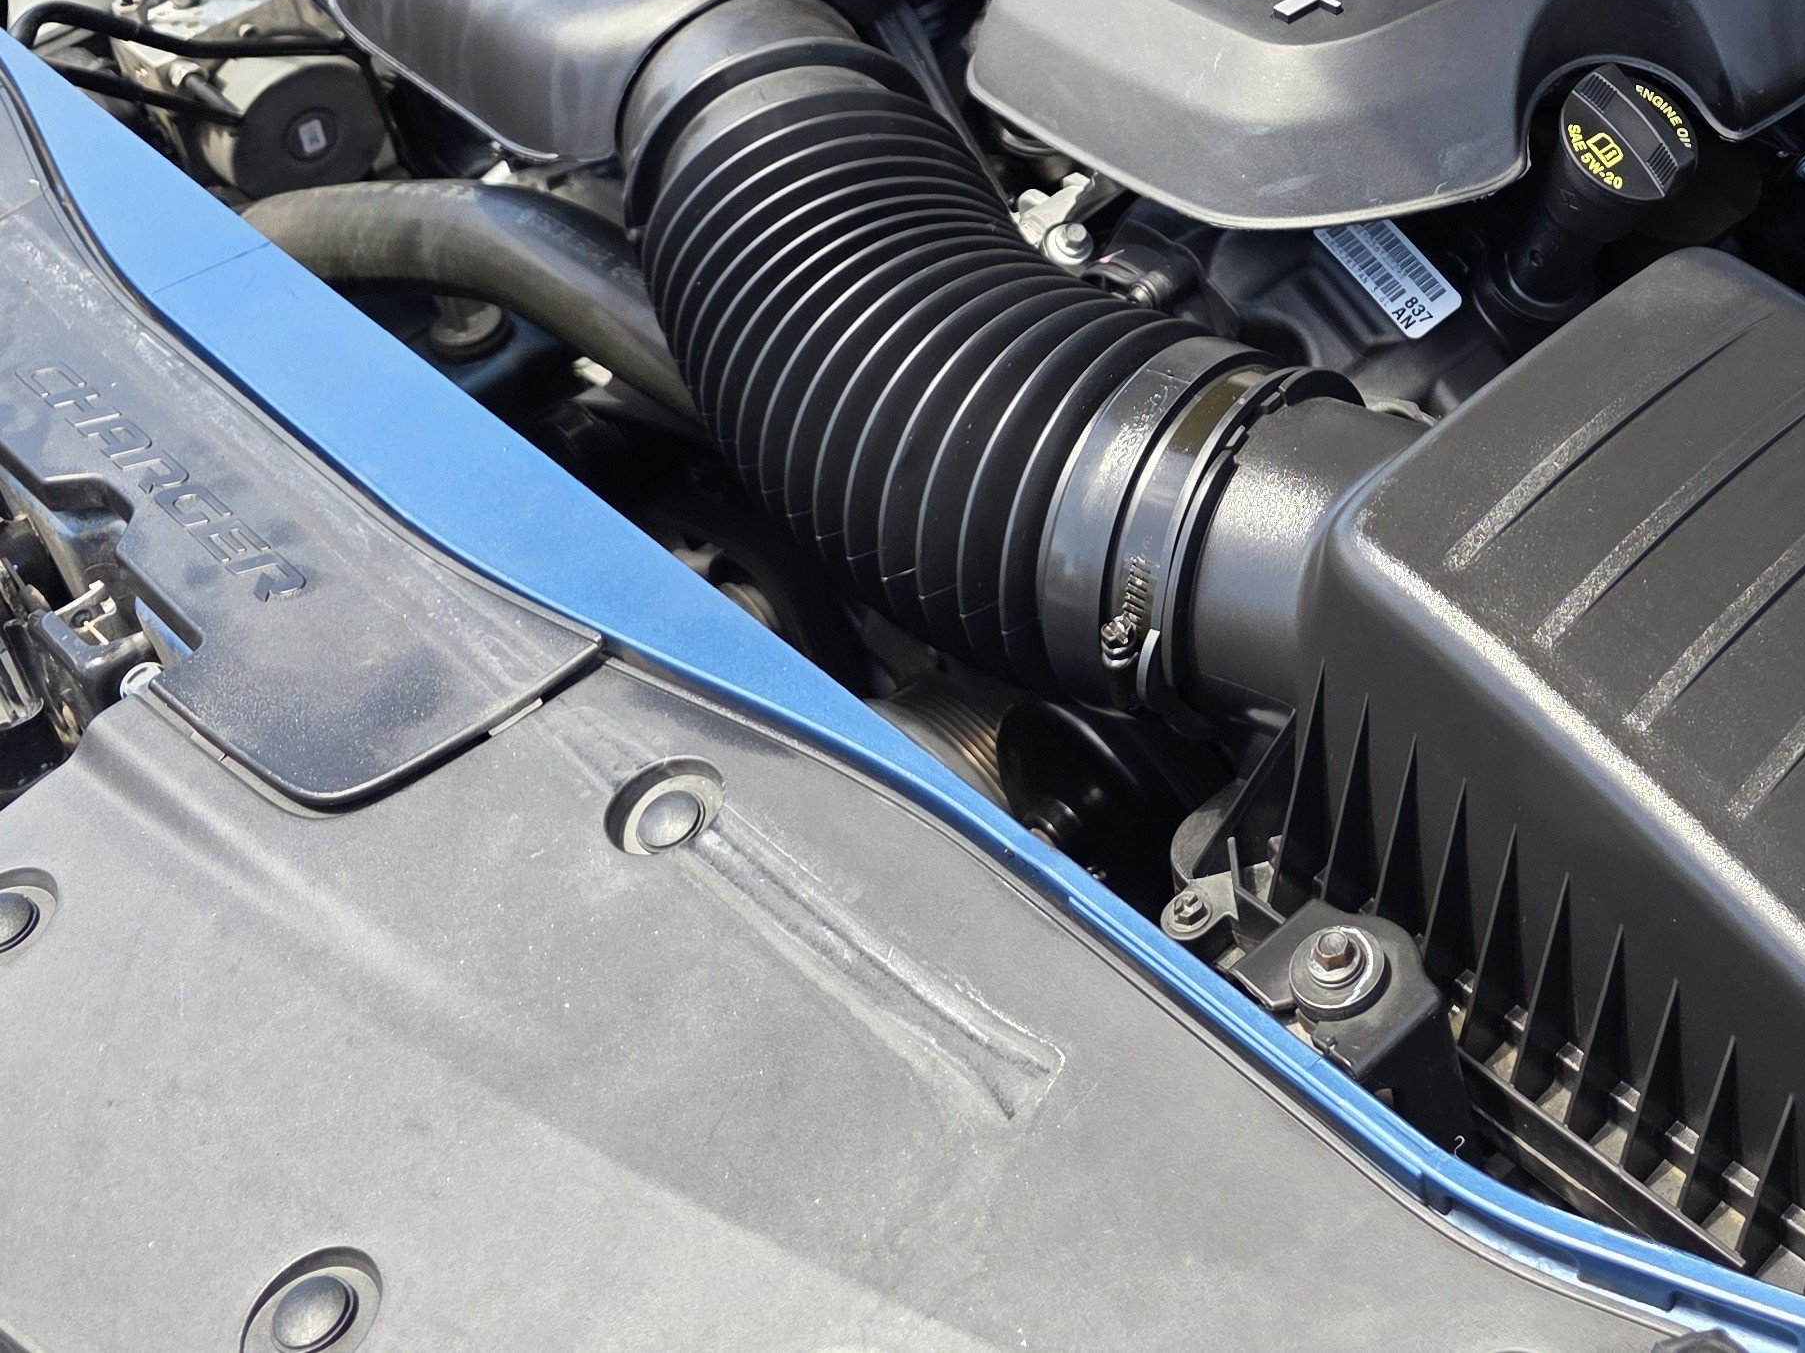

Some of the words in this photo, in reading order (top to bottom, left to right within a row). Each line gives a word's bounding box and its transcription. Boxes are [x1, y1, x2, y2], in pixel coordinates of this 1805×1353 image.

[1567, 123, 1587, 152] SAE
[1580, 152, 1623, 190] 5W-20
[1391, 306, 1417, 330] AN
[1405, 296, 1433, 323] 837
[14, 360, 307, 603] CHARGER
